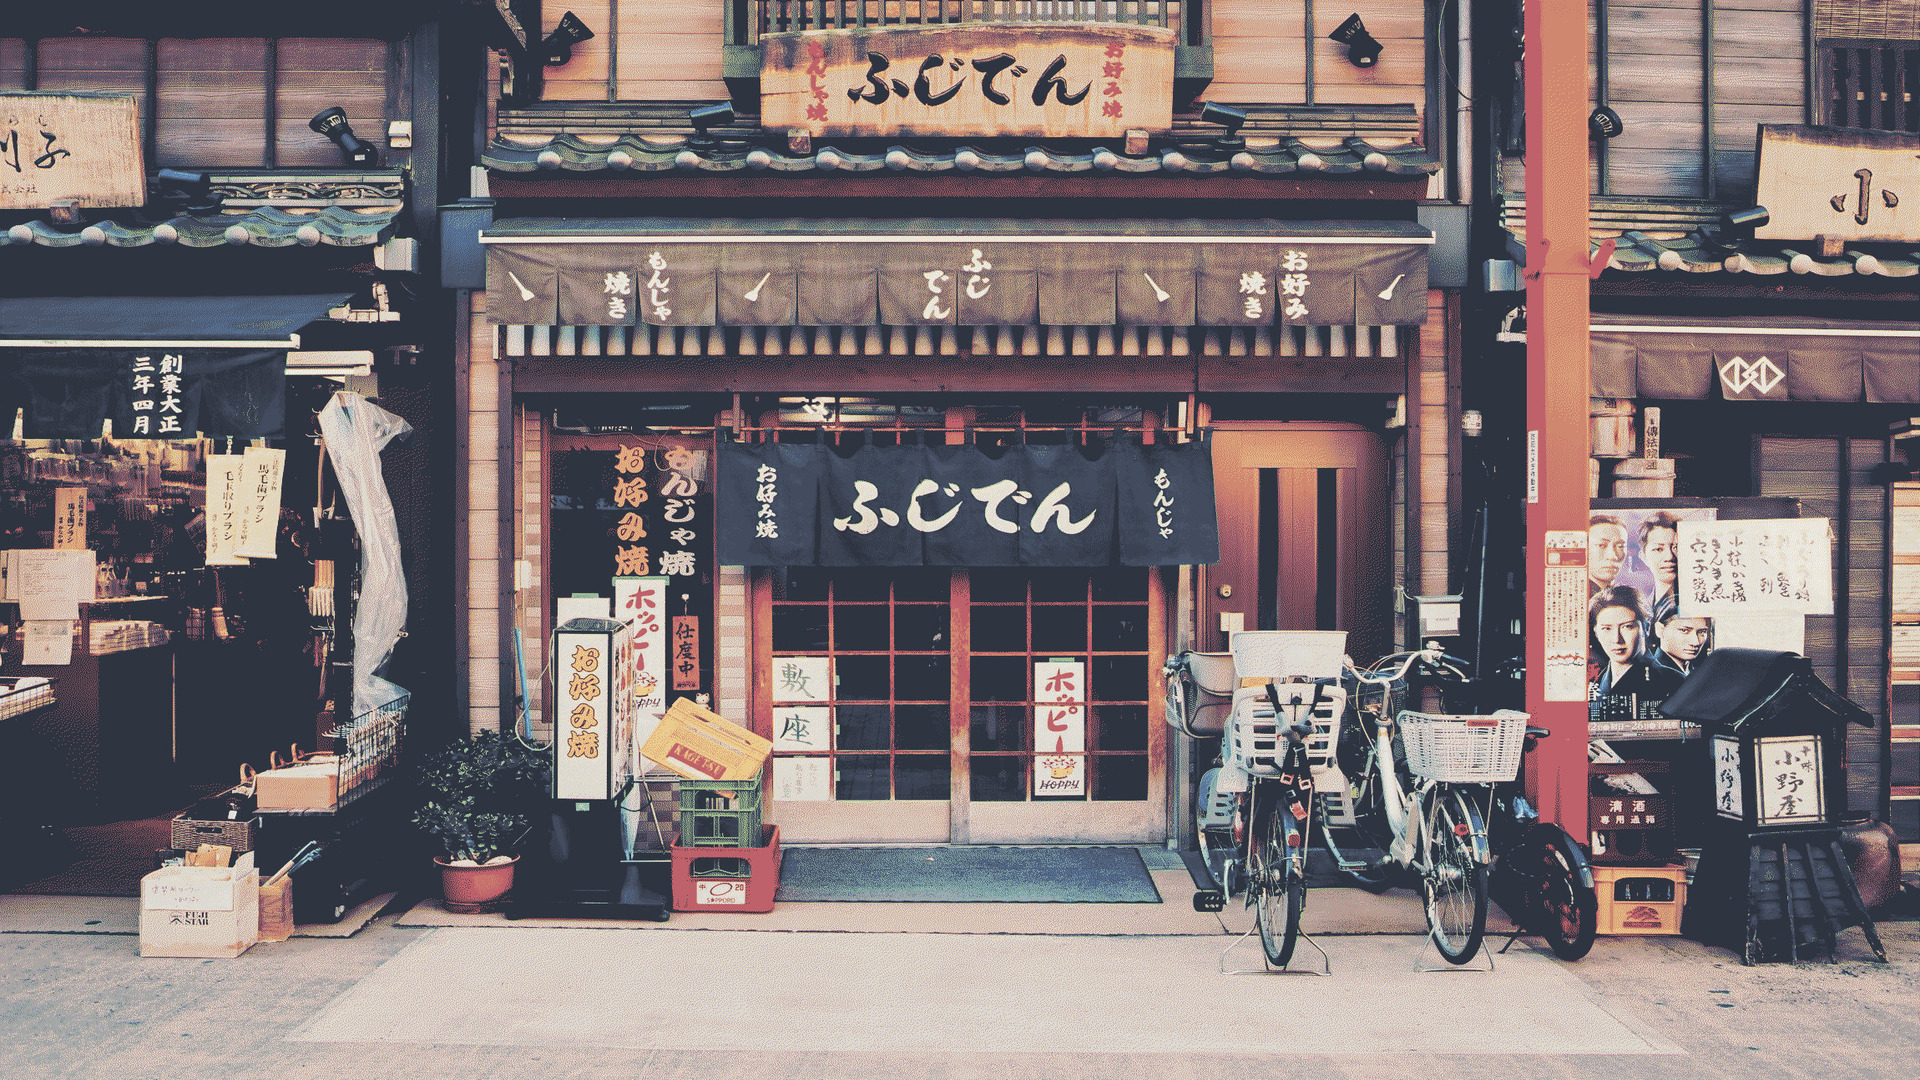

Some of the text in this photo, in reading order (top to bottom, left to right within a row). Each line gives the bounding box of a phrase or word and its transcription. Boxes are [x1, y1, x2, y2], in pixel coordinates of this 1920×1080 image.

[847, 51, 1092, 106] ふじでん
[1101, 40, 1125, 119] お好み焼
[1829, 168, 1899, 225] 小
[603, 272, 631, 319] 焼き
[647, 252, 672, 321] もんじゃ
[922, 270, 951, 321] でん
[963, 249, 992, 299] ふじ
[1239, 271, 1267, 319] 焼き
[1281, 251, 1311, 320] お好み
[132, 355, 155, 435] 三年四月
[159, 354, 183, 433] 創業大正
[613, 444, 650, 577] お好み焼
[658, 468, 698, 577] んじゃ焼
[755, 463, 780, 539] お好み焼
[833, 478, 1097, 535] ふじでん
[1153, 468, 1175, 539] もんじゃ
[625, 585, 659, 672] ホッピー
[676, 622, 696, 677] 仕度中
[566, 644, 602, 759] お好み焼
[779, 662, 816, 699] 敷
[779, 714, 813, 745] 座
[1609, 800, 1646, 812] 清酒
[1775, 750, 1804, 817] 小野屋
[185, 911, 209, 919] FUJI
[185, 918, 209, 926] STAR
